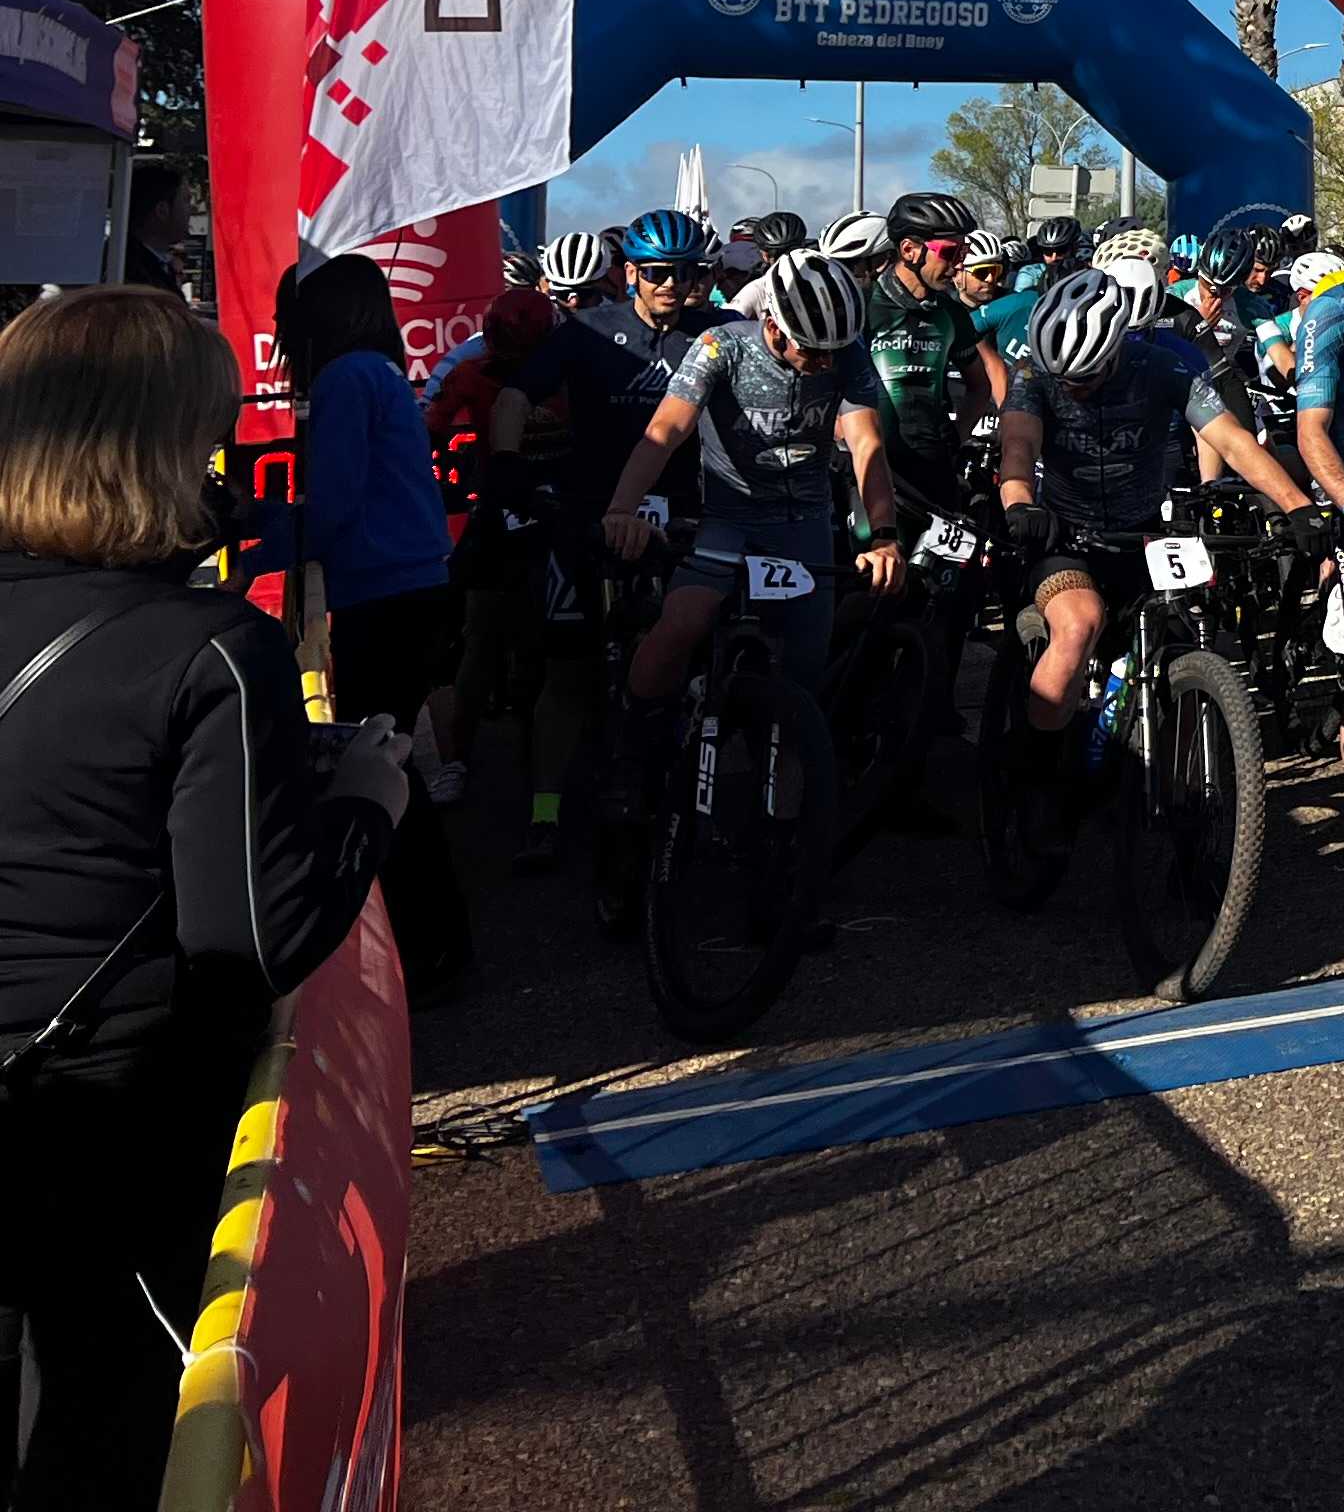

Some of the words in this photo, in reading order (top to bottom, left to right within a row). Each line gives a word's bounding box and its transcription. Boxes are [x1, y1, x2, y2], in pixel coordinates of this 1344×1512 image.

[816, 31, 875, 49] Cabeza
[876, 32, 903, 49] del
[938, 520, 964, 553] 38
[760, 561, 797, 588] 22
[1167, 553, 1186, 580] 5
